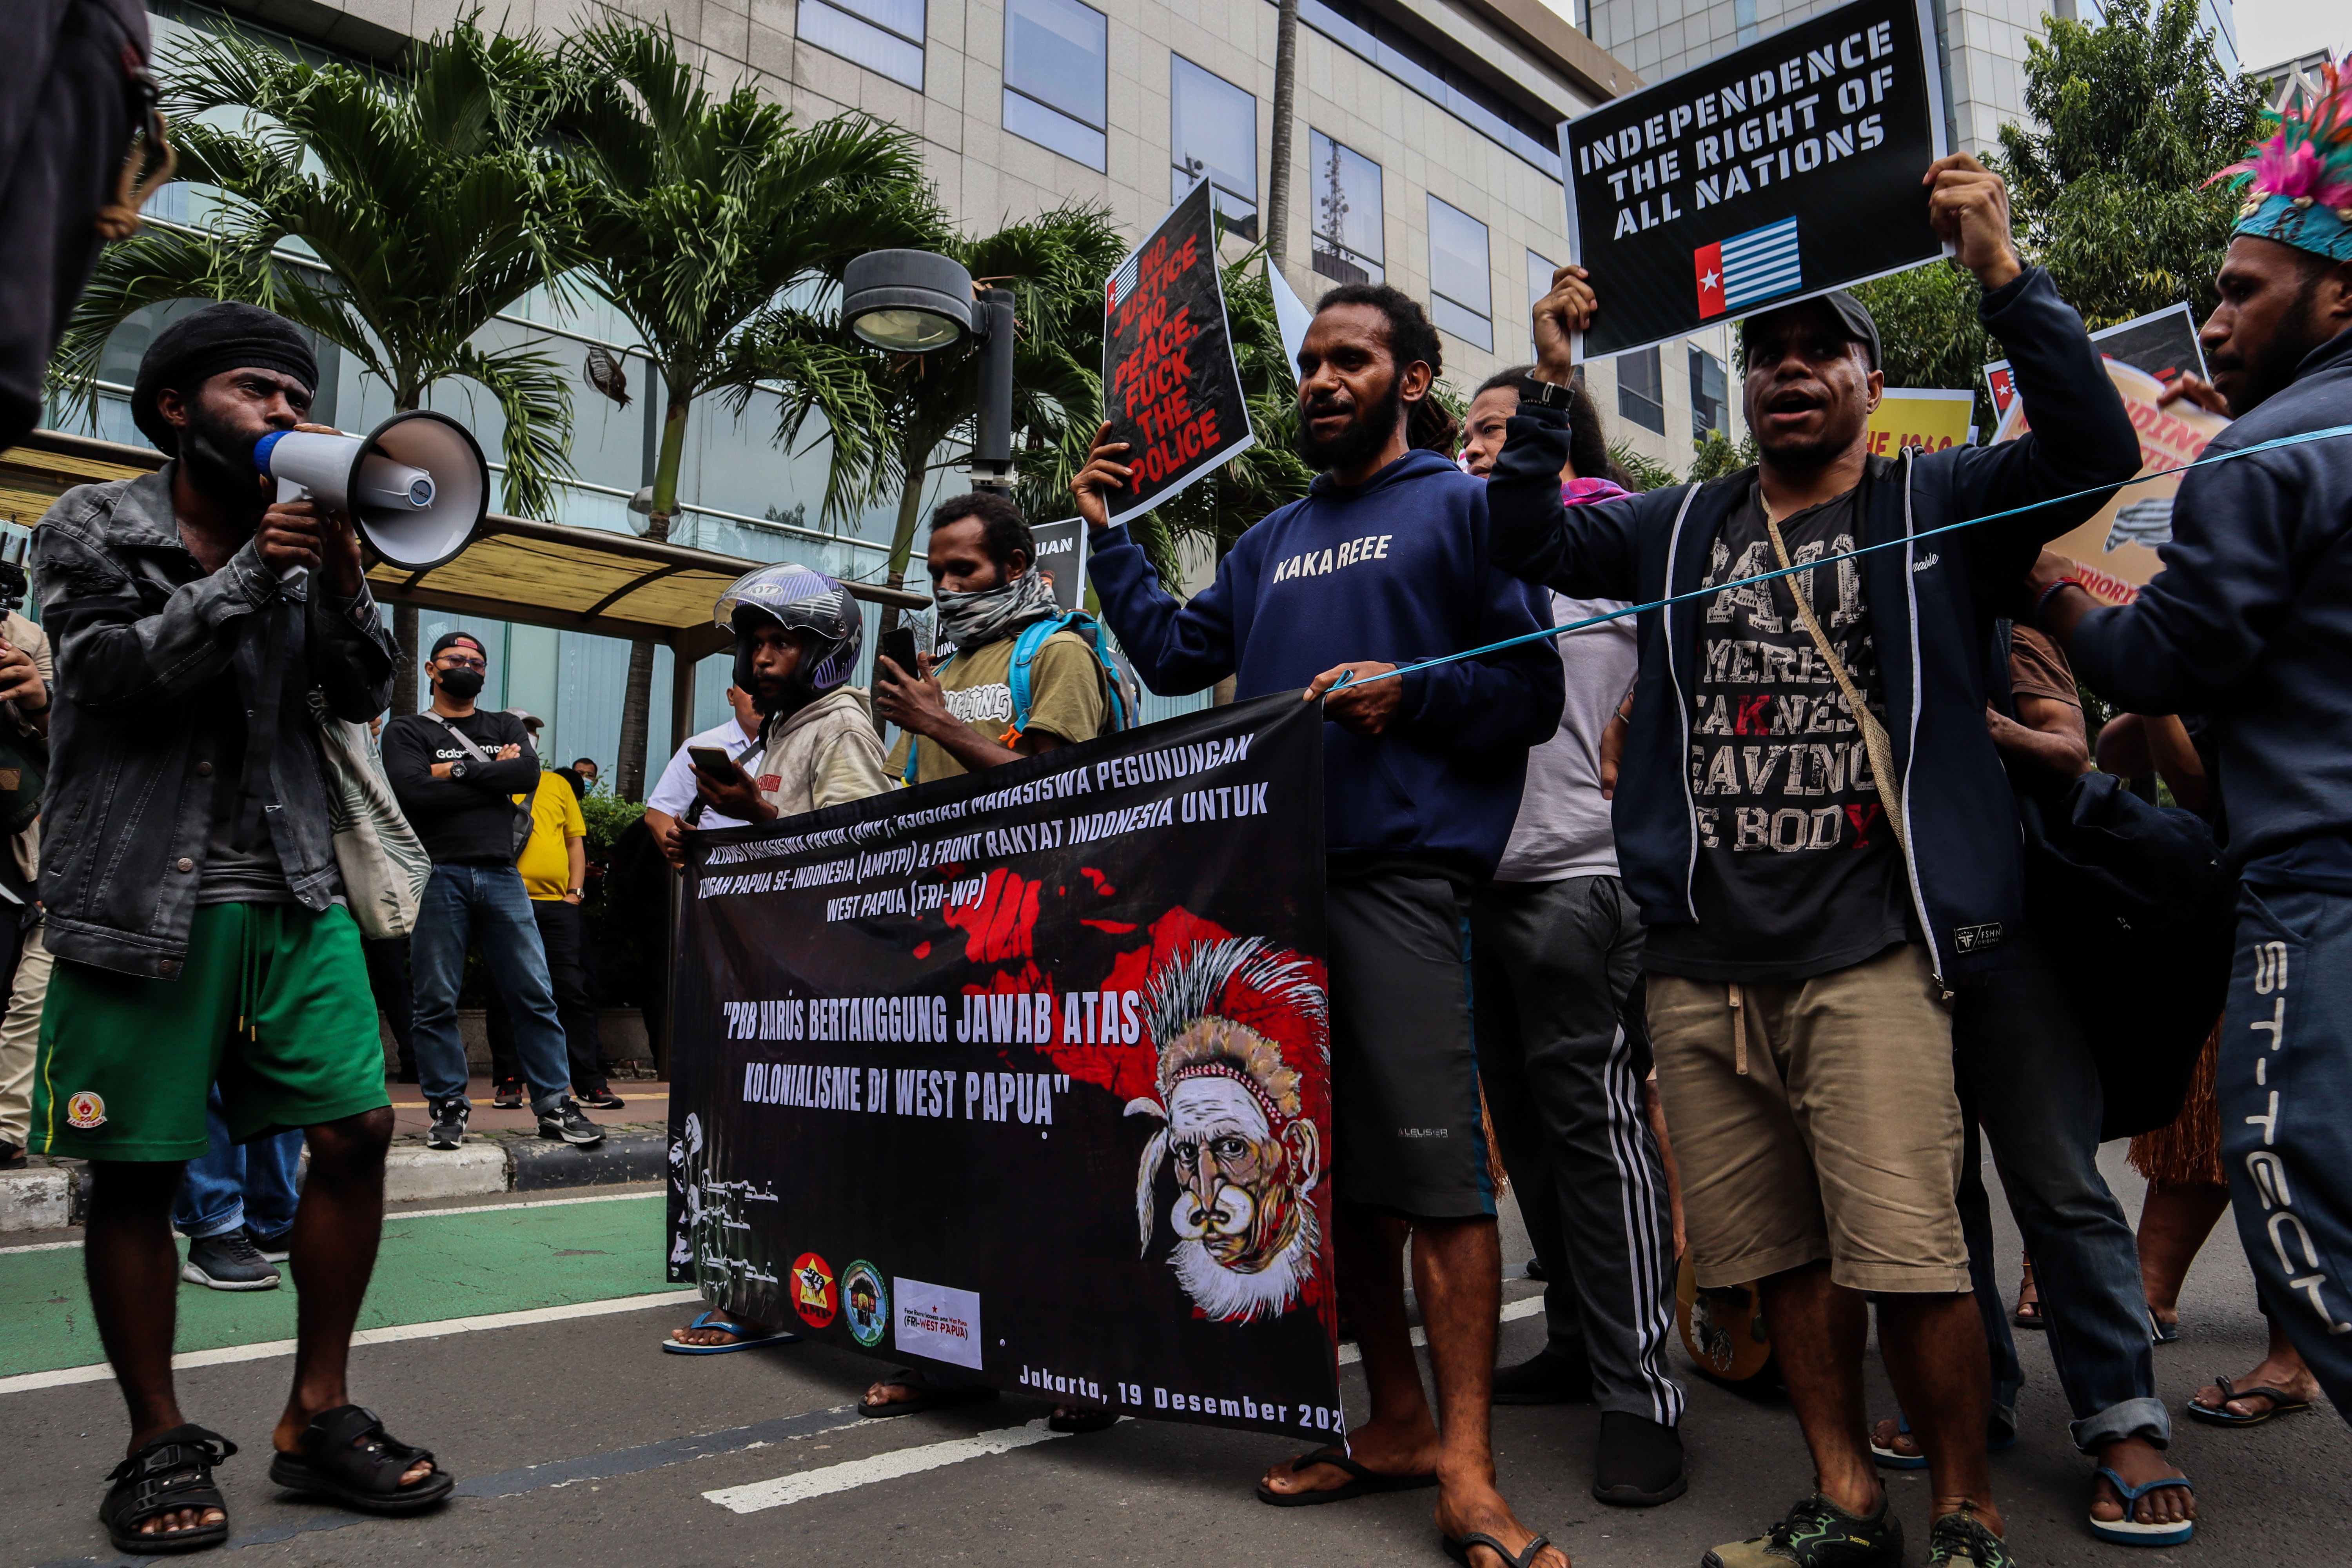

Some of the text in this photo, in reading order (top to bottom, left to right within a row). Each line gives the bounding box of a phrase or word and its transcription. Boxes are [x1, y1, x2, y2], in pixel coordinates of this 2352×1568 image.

[1580, 19, 1893, 175] INDEPENDENCE
[1607, 65, 1893, 202] THE RIGHT OF
[1614, 113, 1884, 241] ALL NATIONS
[1113, 234, 1198, 338] JUSTICE
[1141, 235, 1167, 283] NO
[1138, 295, 1166, 343] NO
[1114, 306, 1199, 394] PEACE,
[1125, 345, 1192, 419] FUCK
[1136, 385, 1191, 446] THE
[1129, 408, 1221, 495] POLICE
[1273, 535, 1392, 584] KAKA REEE
[1704, 636, 1876, 683] MEREL
[705, 844, 747, 865] ALIANSI
[745, 835, 808, 860] MAHASISWA
[806, 827, 848, 849] PAPUA
[971, 766, 1092, 814] MAHASISWA
[1097, 733, 1254, 791] PEGUNUNGAN
[1734, 804, 1880, 853] BODY
[698, 782, 1269, 899] TENGAH PAPUA SE-INDONESIA (AMPTPI) & FRONT RAKYAT INDONESIA UNTUK
[827, 871, 987, 922] WEST PAPUA (FRI-WP)
[1982, 929, 2000, 938] FSHN
[723, 990, 1140, 1044] "PBB HARUS BERTANGGUNG JAWAB ATAS
[743, 1062, 1070, 1125] KOLONIALISME DI WEST PAPUA"
[799, 1303, 832, 1319] AMP
[904, 1316, 967, 1341] (FRI-WEST PAPUA)
[1019, 1365, 1108, 1405] Jakarta,
[1118, 1382, 1142, 1405] 19
[1154, 1387, 1287, 1422] Desember
